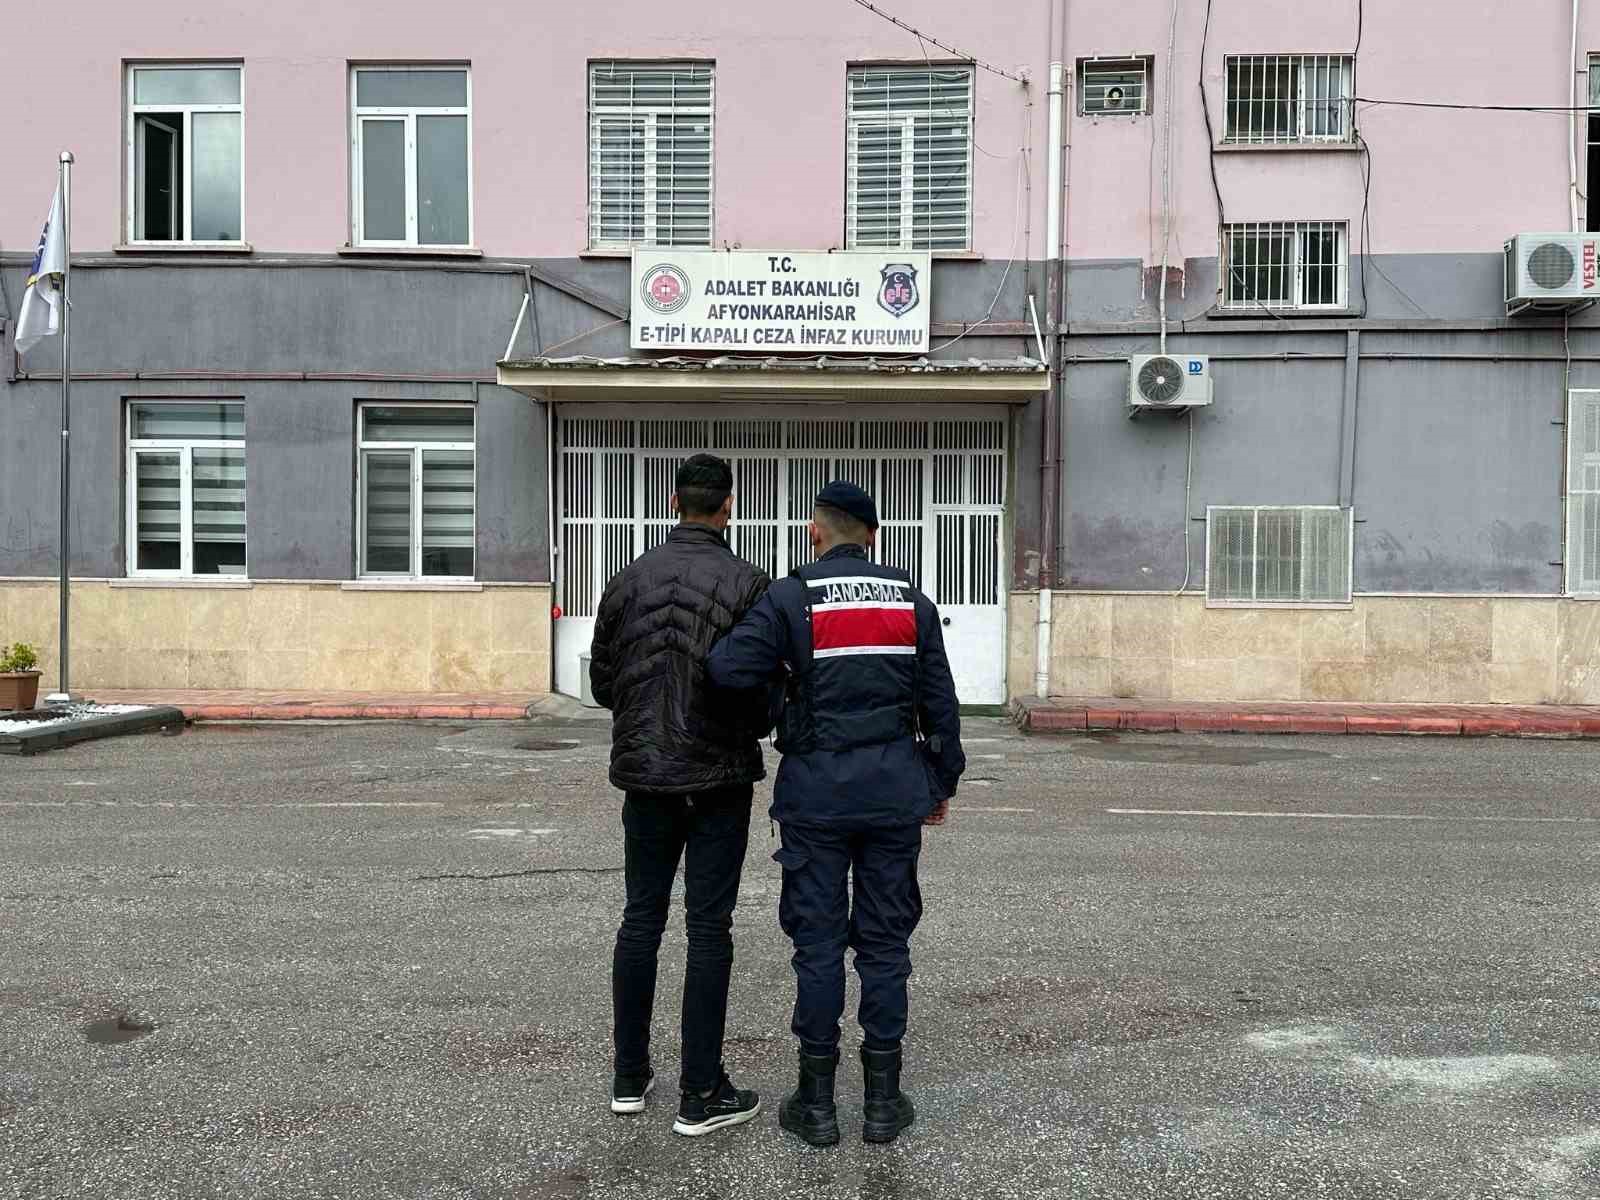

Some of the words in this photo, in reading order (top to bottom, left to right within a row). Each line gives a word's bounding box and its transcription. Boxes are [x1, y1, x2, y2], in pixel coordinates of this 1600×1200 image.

[768, 256, 797, 273] T.C.
[1583, 240, 1595, 289] VESTEL
[704, 280, 766, 297] ADALET
[772, 277, 860, 298] BAKANLIĞI
[707, 301, 856, 321] AFYONKARAHİSAR
[640, 322, 686, 342] E-TİPİ
[691, 327, 748, 344] KAPALI
[753, 328, 795, 344] CEZA
[800, 325, 847, 345] İNFAZ
[852, 328, 923, 346] KURUMU
[822, 583, 904, 602] JANDARMA
